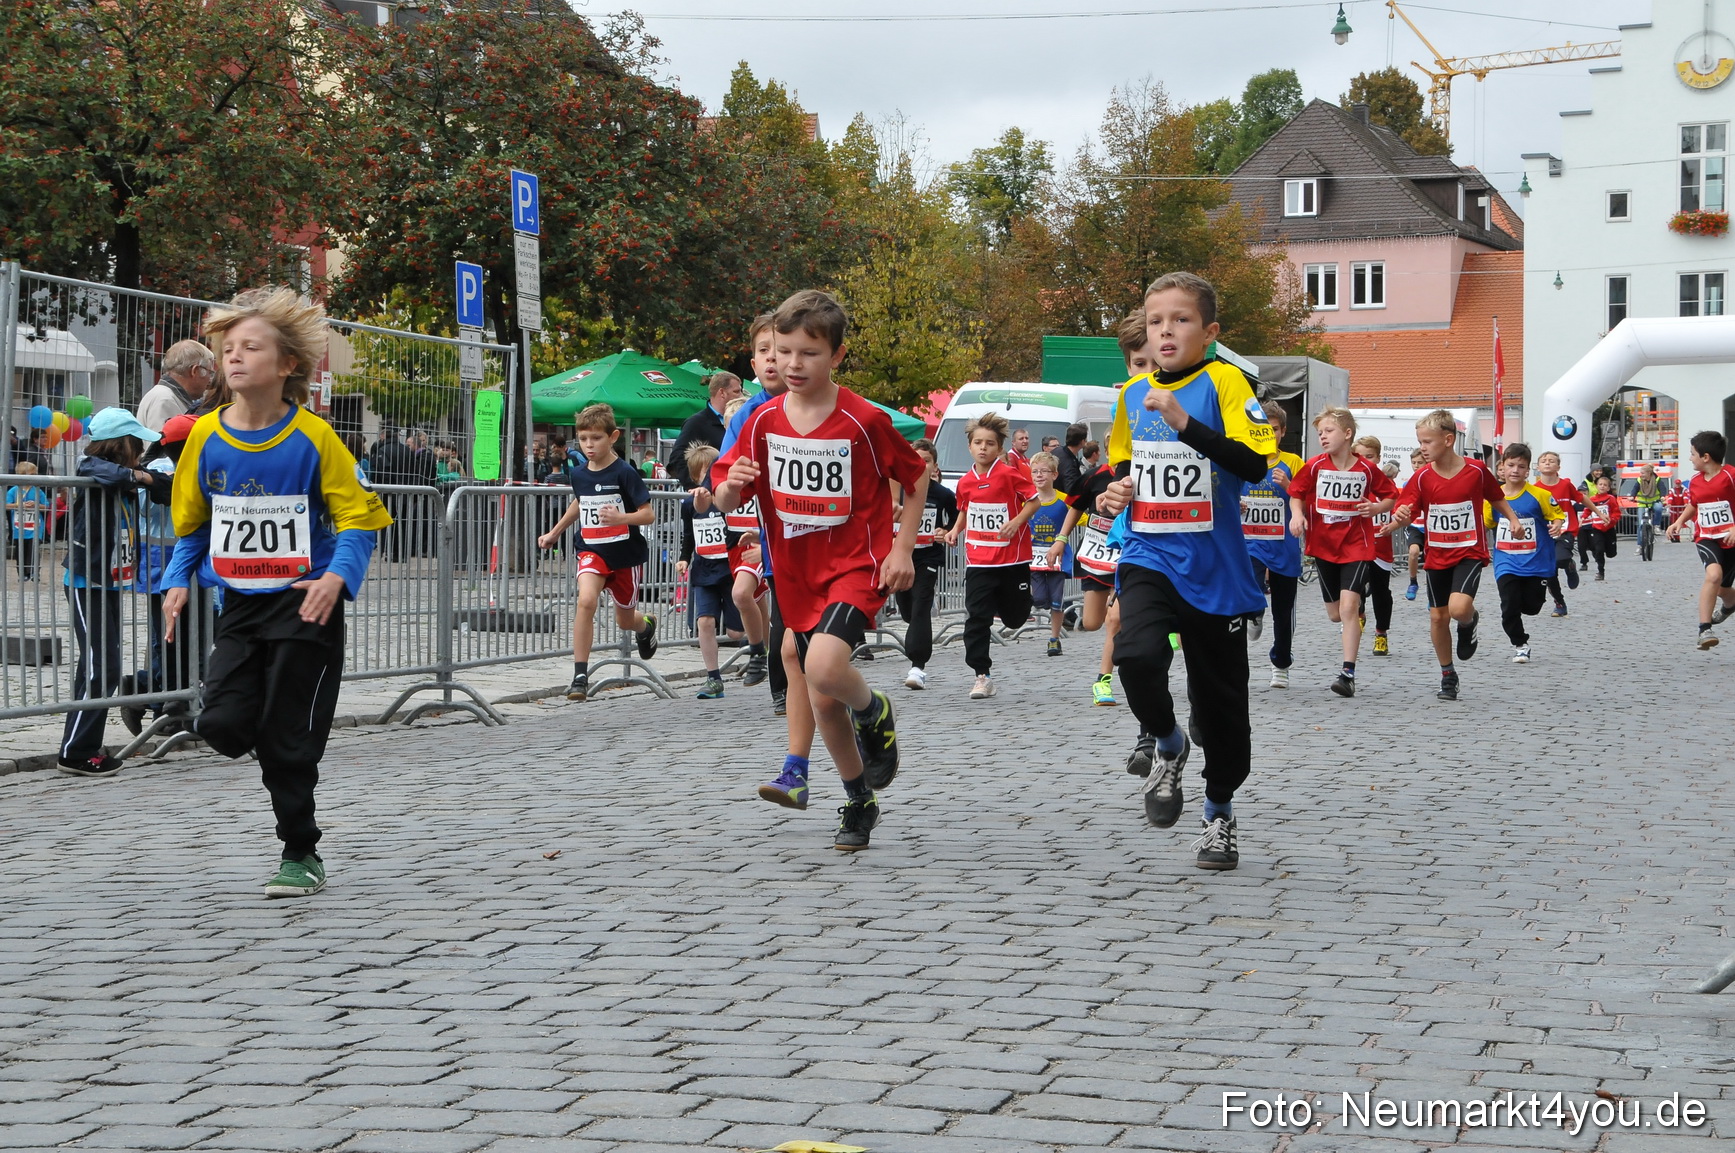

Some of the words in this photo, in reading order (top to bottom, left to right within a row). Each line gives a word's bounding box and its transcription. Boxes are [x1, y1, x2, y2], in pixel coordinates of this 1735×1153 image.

[518, 180, 532, 223] P
[462, 270, 477, 317] P
[1249, 427, 1275, 437] PART
[769, 441, 790, 454] PARTL
[792, 446, 835, 457] Neumarkt
[1148, 450, 1193, 460] Neumarkt
[1383, 445, 1414, 453] Bayerisch
[774, 456, 843, 493] 7098
[1135, 464, 1202, 498] 7162
[1322, 481, 1362, 499] 7043
[214, 504, 239, 515] PARTL
[241, 505, 290, 515] Neumarkt
[785, 498, 825, 515] Philipp
[1143, 507, 1184, 520] Lorenz
[970, 514, 1003, 530] 7163
[1245, 508, 1281, 524] 7000
[1430, 513, 1469, 531] 7057
[1700, 510, 1729, 525] 7105
[221, 519, 297, 553] 7201
[231, 561, 290, 576] Jonathan
